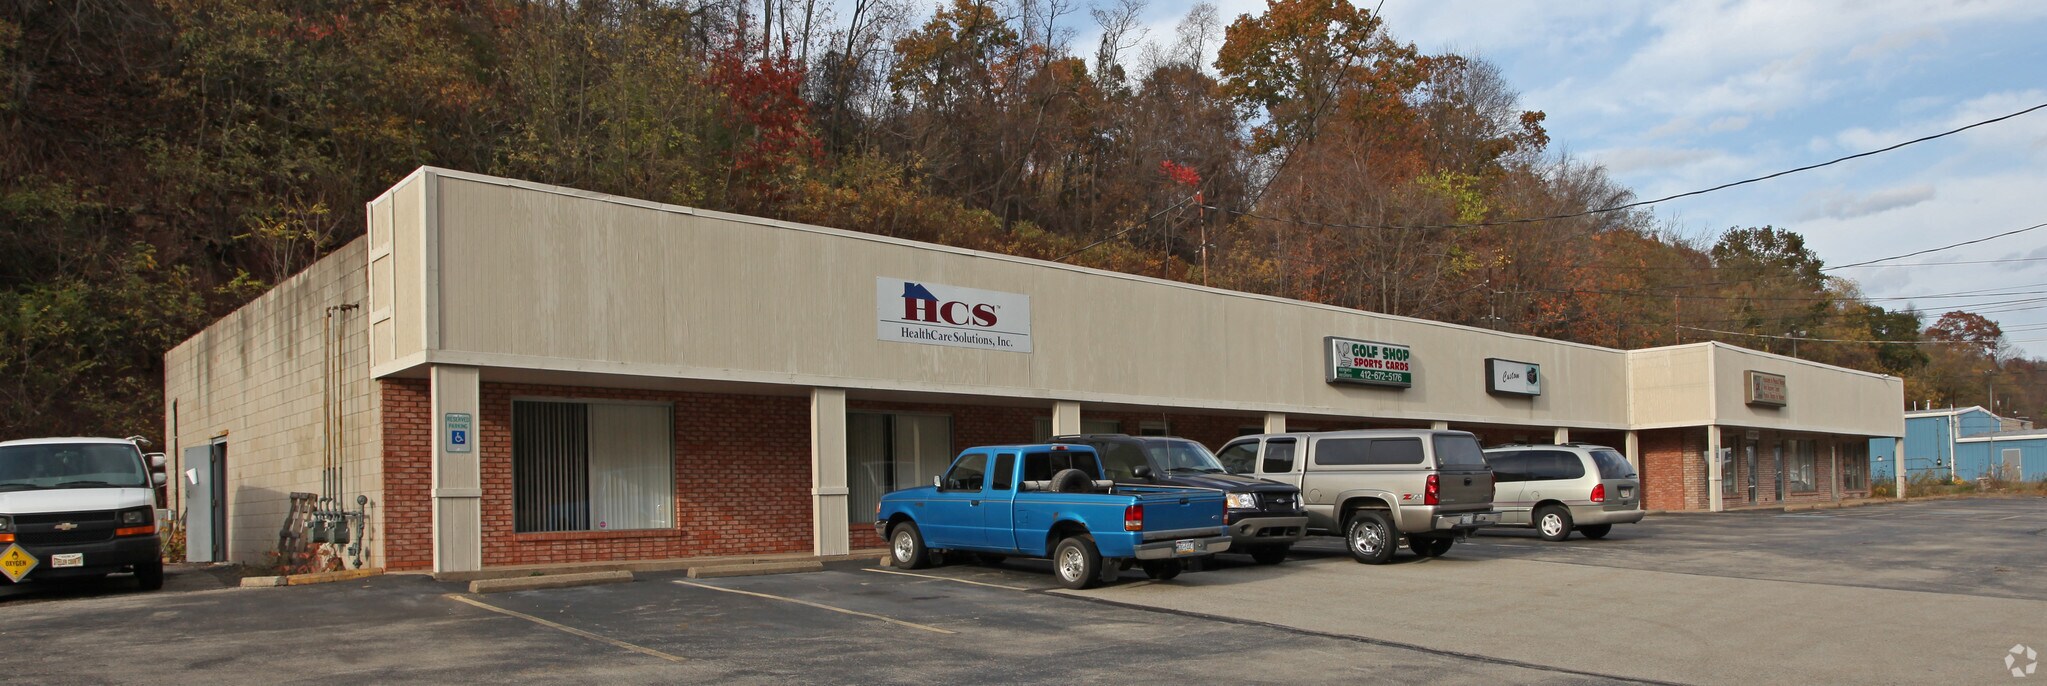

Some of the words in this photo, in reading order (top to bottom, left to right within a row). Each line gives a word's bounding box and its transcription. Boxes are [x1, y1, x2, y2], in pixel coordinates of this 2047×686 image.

[901, 296, 997, 327] HCS
[901, 327, 951, 342] HealthCare
[953, 332, 995, 347] Solutions,
[997, 336, 1013, 347] Inc.
[1352, 343, 1378, 358] GOLF
[1382, 347, 1409, 361] SHOP
[1354, 358, 1382, 369] SPORTS
[1385, 361, 1409, 371] CARDS
[1360, 371, 1402, 382] 412-672-5176
